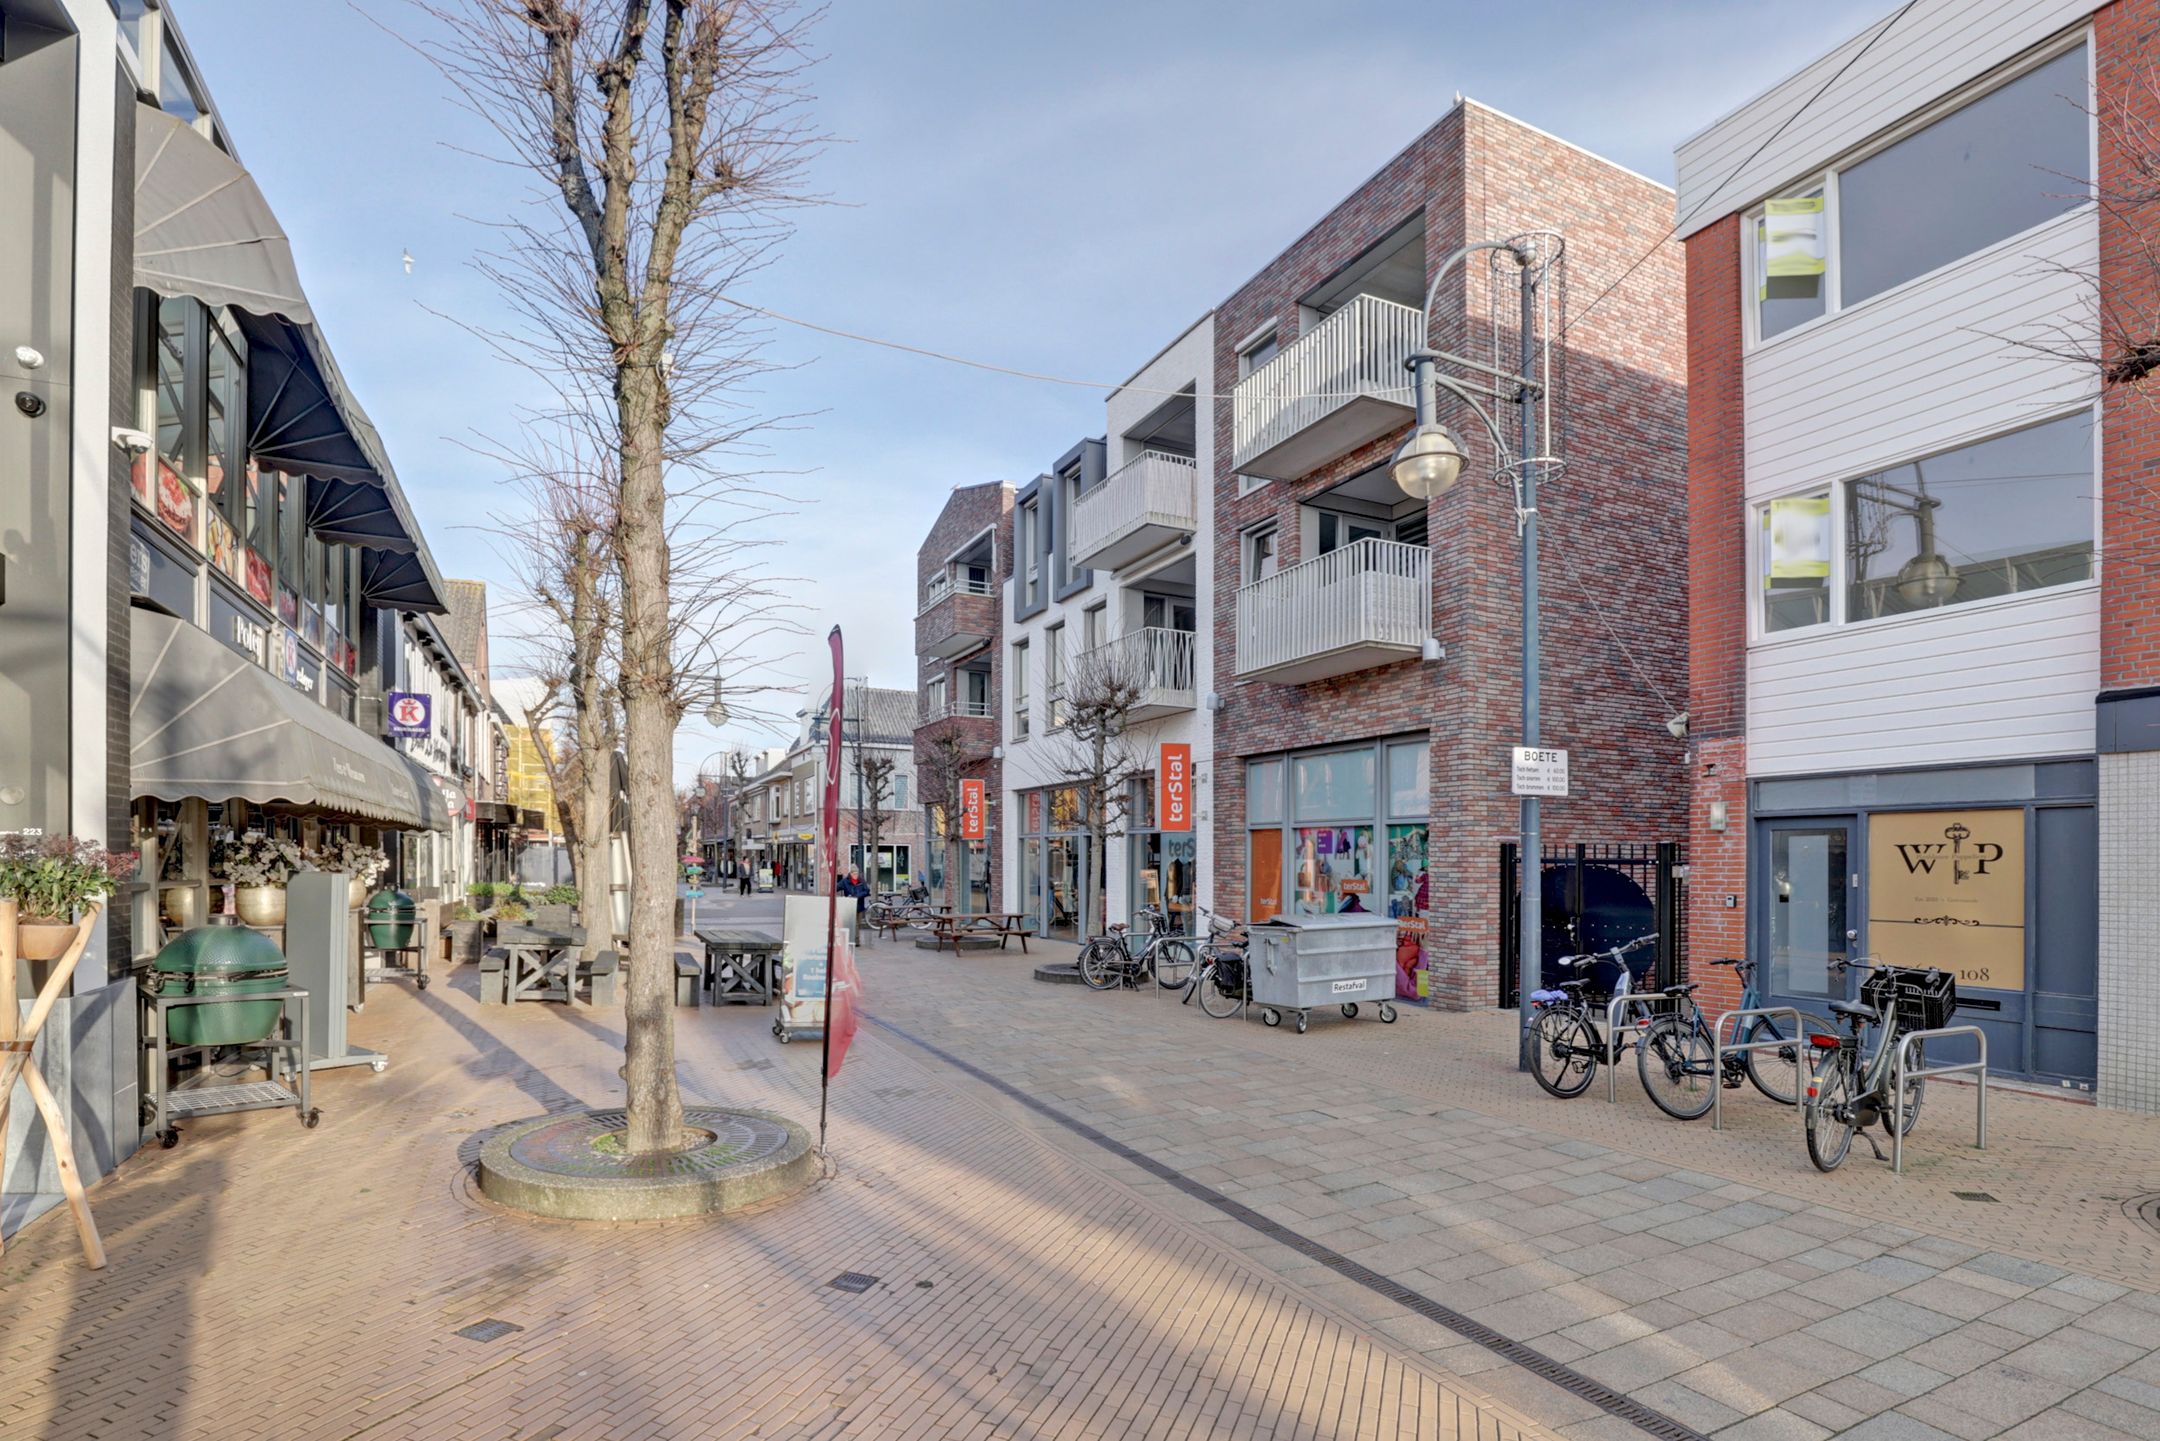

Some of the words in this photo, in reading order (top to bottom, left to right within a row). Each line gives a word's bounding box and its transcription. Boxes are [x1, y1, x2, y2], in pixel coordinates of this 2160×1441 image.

[399, 705, 419, 722] K
[1524, 751, 1557, 762] BOETE
[1167, 753, 1183, 822] terStal
[967, 787, 978, 833] terStal
[22, 827, 42, 836] 223
[1959, 967, 1990, 981] 108
[1334, 980, 1365, 991] Restafval
